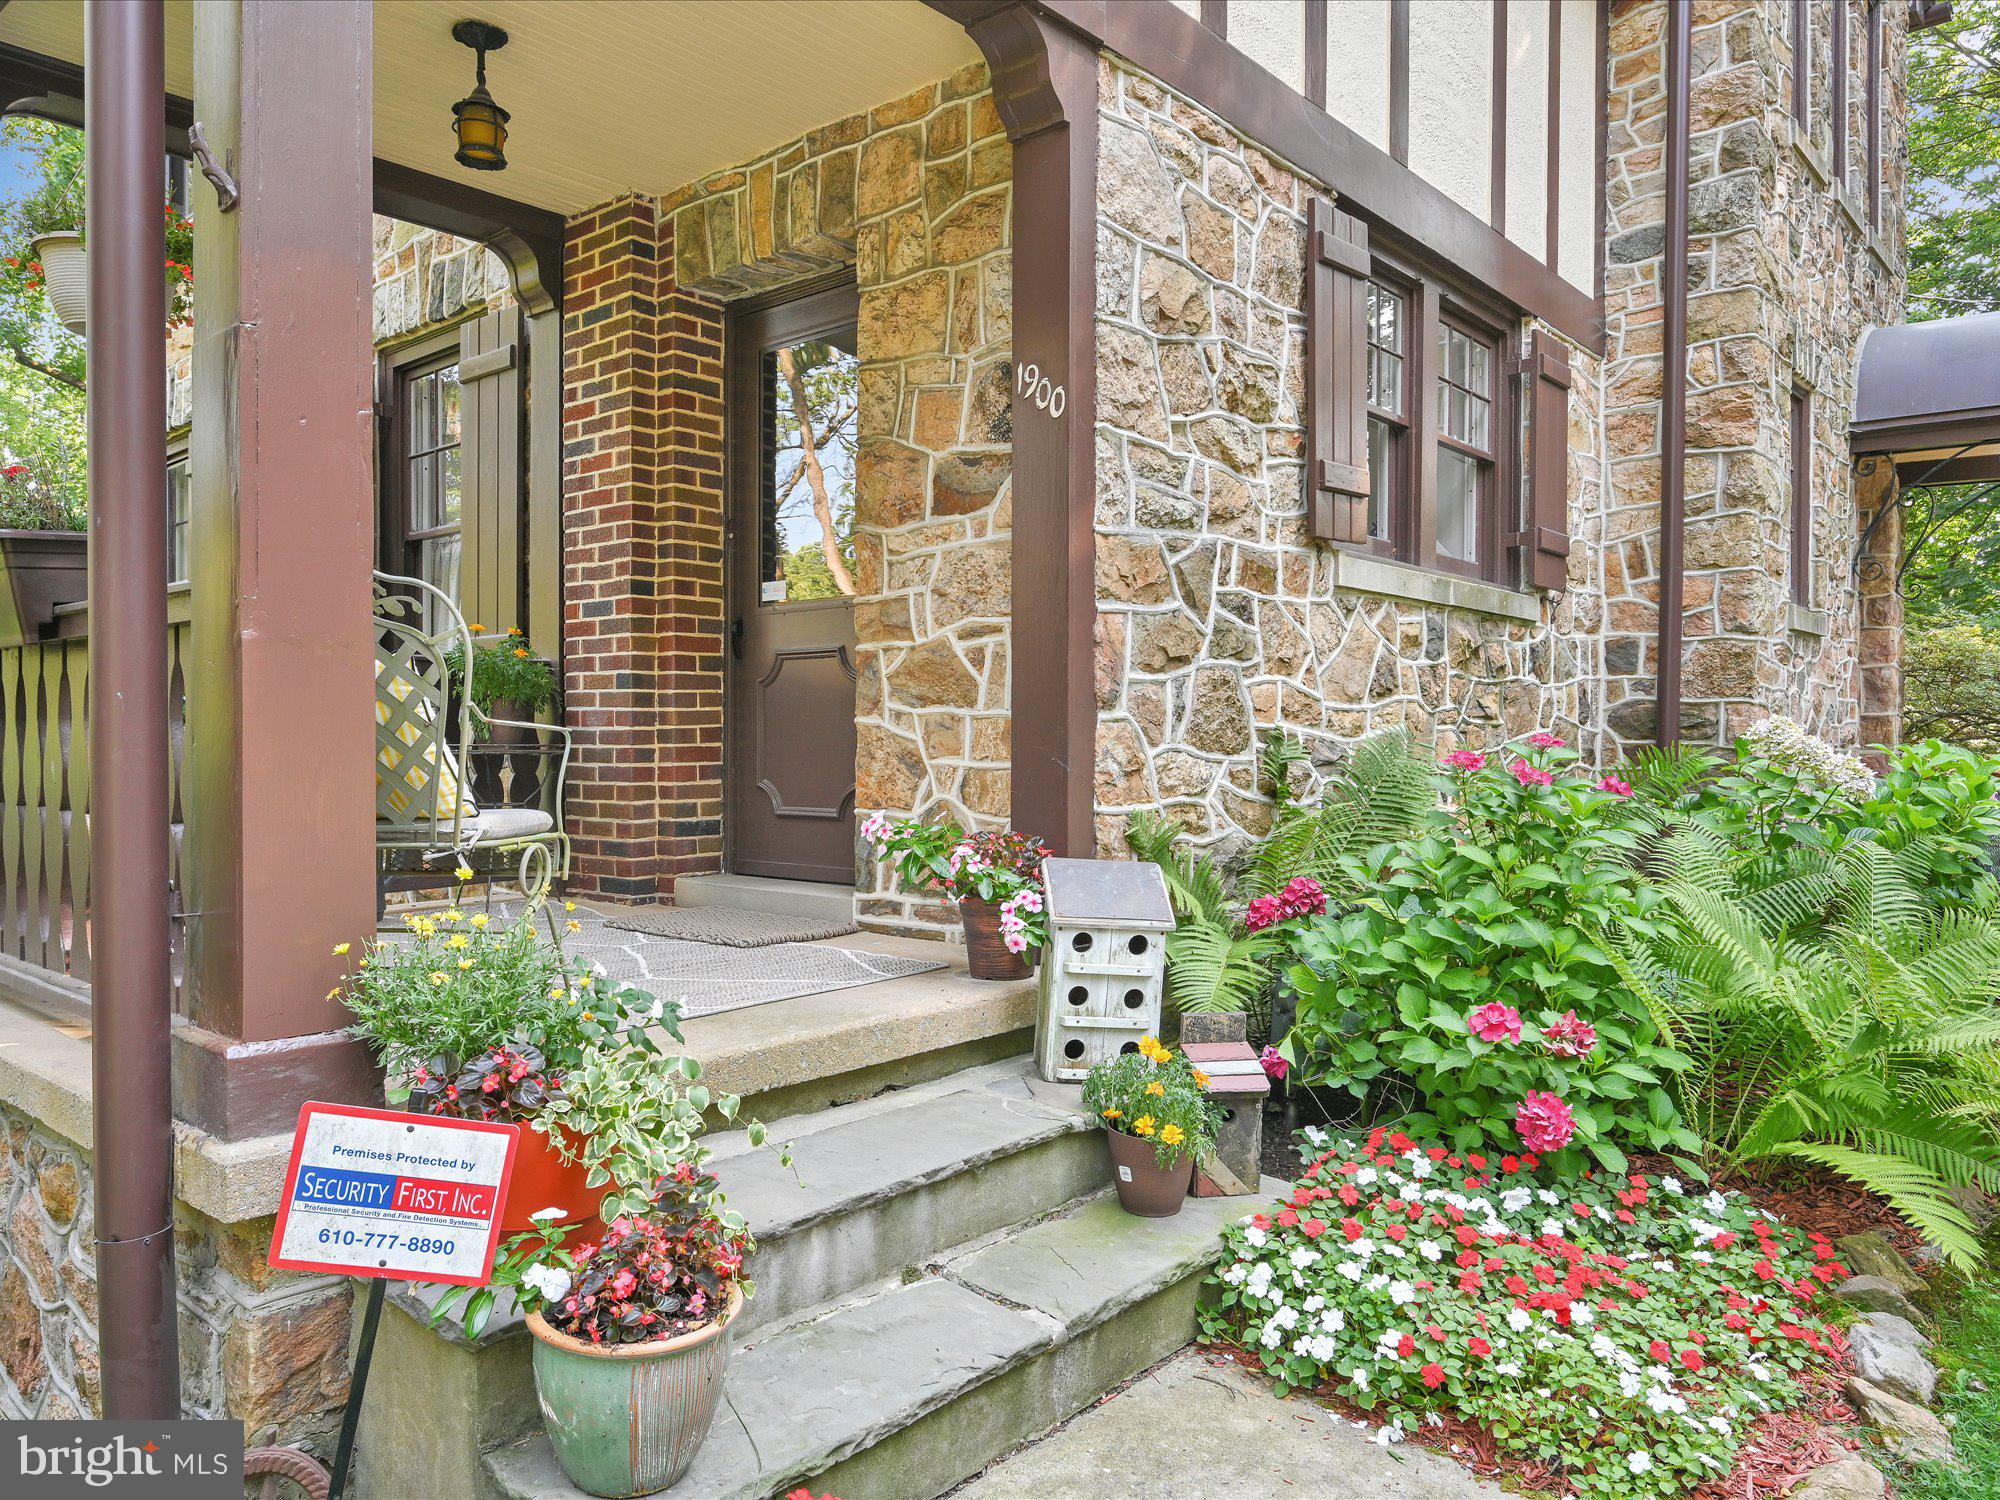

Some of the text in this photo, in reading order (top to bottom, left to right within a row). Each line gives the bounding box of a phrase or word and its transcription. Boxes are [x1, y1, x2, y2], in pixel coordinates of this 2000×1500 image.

[1017, 362, 1066, 419] 1900
[332, 1145, 476, 1172] Premises Protected by
[301, 1171, 487, 1215] SECURITY FIRST, INC.
[303, 1203, 479, 1228] Professional Security and Fire Detection Systems
[318, 1228, 455, 1256] 610-777-8890
